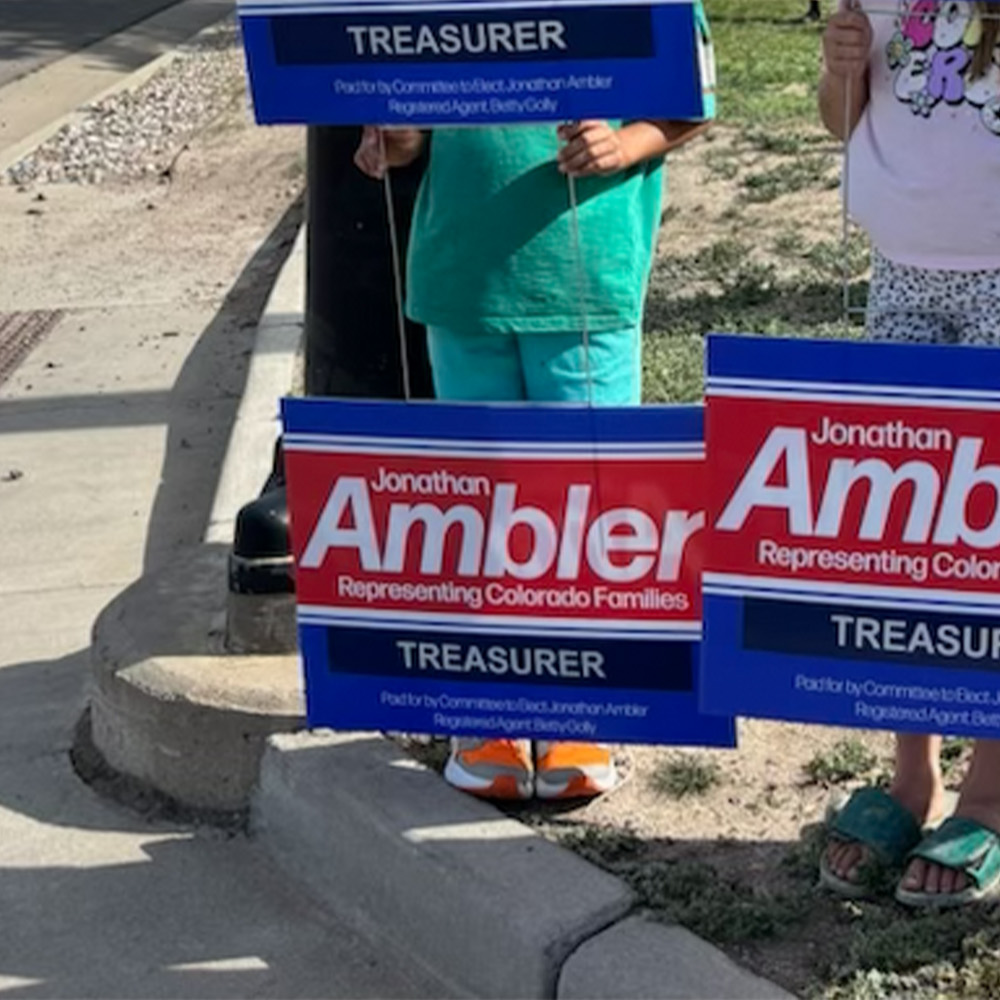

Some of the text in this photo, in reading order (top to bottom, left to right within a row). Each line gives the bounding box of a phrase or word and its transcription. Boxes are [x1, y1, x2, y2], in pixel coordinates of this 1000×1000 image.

[346, 20, 567, 56] TREASURER
[505, 76, 566, 92] Jonathan
[566, 74, 613, 90] Ambler
[811, 417, 953, 452] Jonathan
[371, 467, 490, 496] Jonathan
[300, 476, 706, 584] Ambler
[758, 541, 928, 581] Representing
[338, 576, 689, 612] Representing Colorado Families
[396, 641, 607, 679] TREASURER
[825, 676, 843, 693] for
[845, 678, 861, 698] by
[549, 700, 602, 716] Jonathan
[854, 700, 929, 722] Registered
